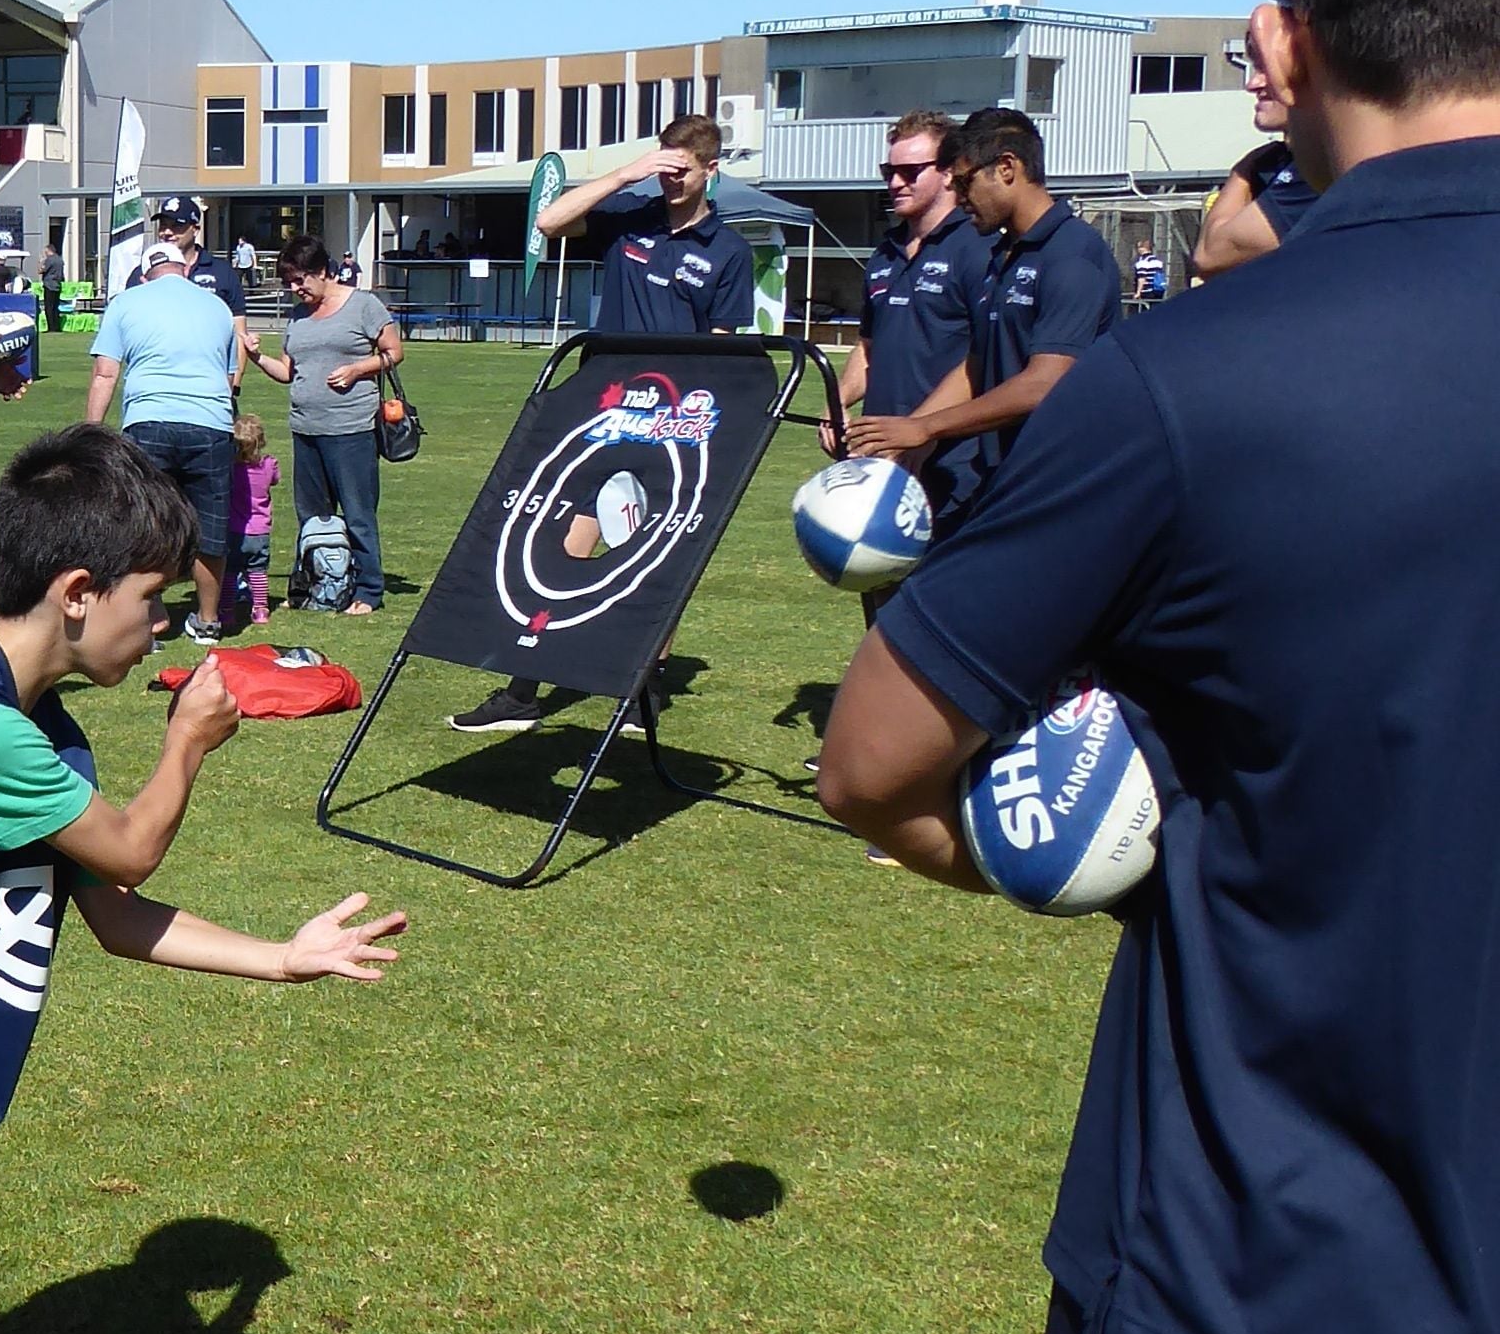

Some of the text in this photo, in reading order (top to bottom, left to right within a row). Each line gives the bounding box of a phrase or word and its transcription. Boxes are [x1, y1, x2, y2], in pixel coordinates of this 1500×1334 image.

[621, 386, 660, 409] nab
[502, 489, 704, 534] 3 5 7 10 7 5 3
